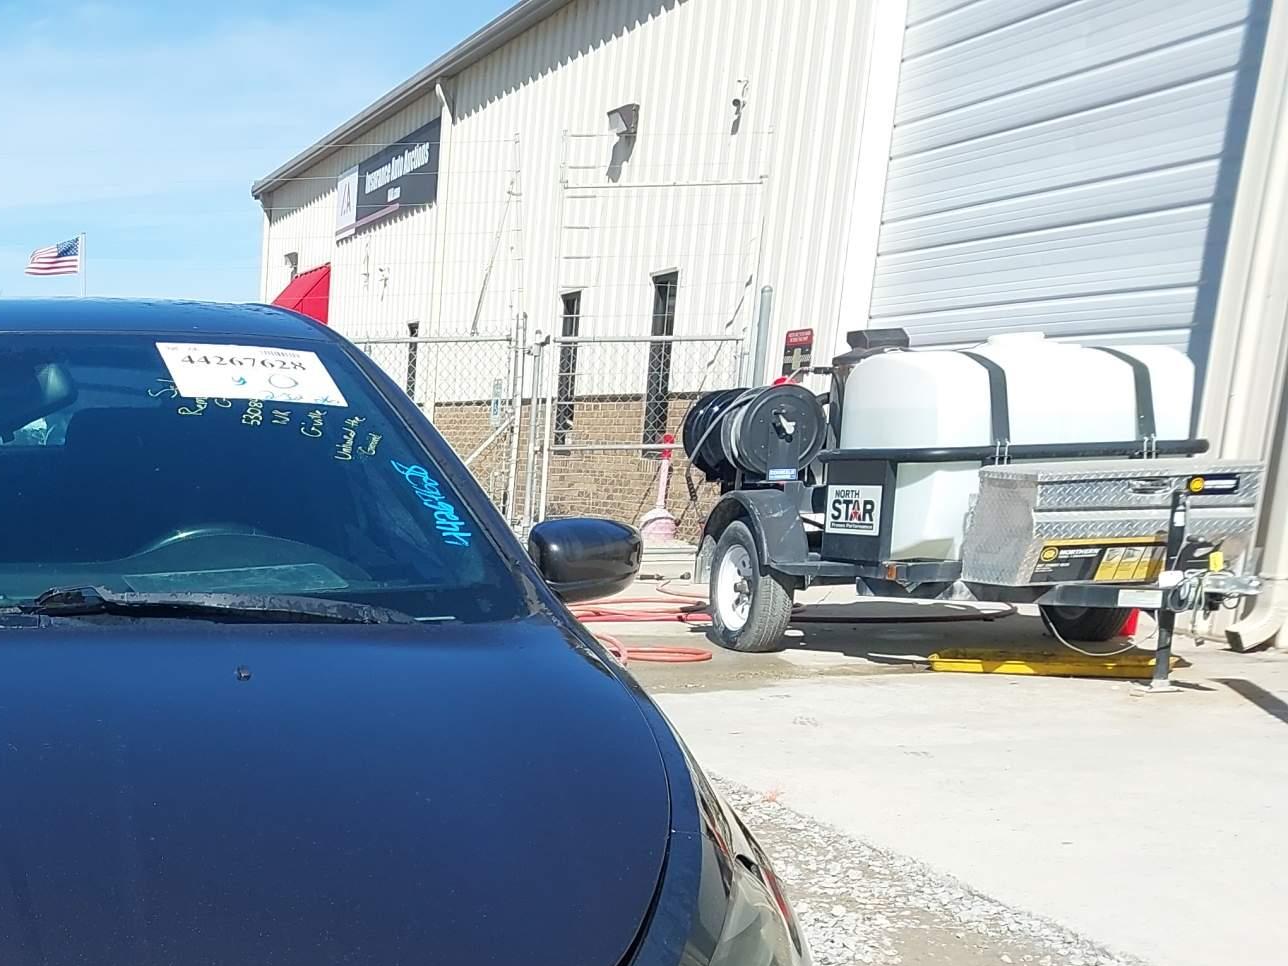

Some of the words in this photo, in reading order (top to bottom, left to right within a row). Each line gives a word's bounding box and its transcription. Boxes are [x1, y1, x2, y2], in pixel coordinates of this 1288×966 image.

[391, 155, 404, 181] Auto
[181, 354, 307, 371] 44267628
[835, 489, 860, 499] NORTH
[831, 499, 875, 522] STAR
